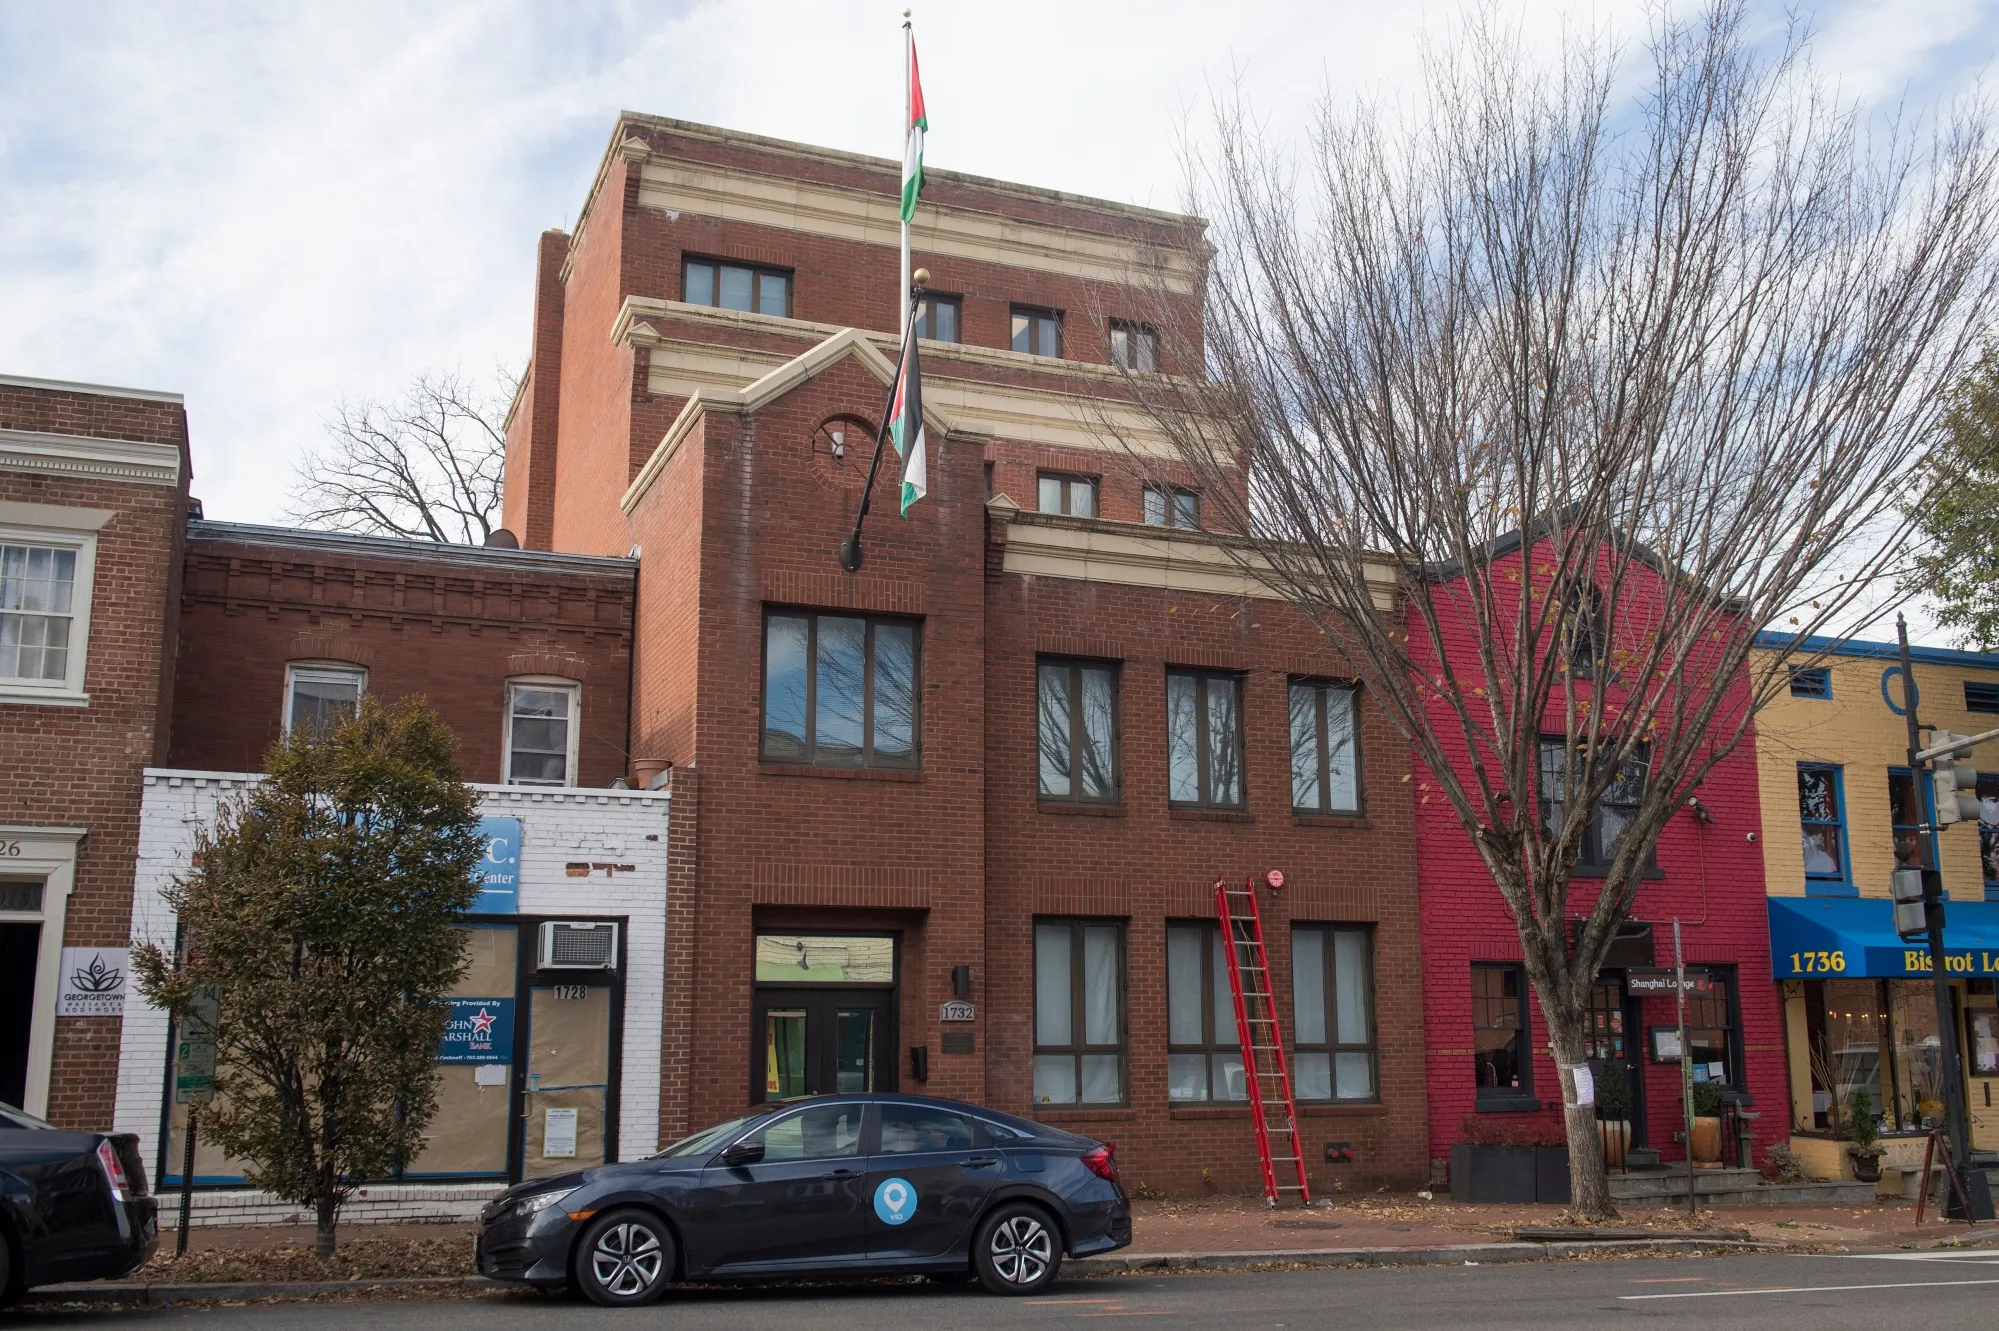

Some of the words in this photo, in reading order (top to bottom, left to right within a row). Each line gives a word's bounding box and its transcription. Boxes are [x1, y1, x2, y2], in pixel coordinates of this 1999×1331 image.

[1790, 950, 1846, 973] 1736
[1904, 949, 1974, 972] Bisrot
[1631, 978, 1665, 990] Shanghai
[64, 993, 126, 1001] GEORGETOWN
[555, 986, 587, 999] 1728
[492, 1000, 501, 1008] By
[943, 1007, 973, 1019] 1732
[445, 1020, 472, 1030] OHN
[469, 1041, 492, 1050] BANK
[889, 1213, 903, 1221] via
